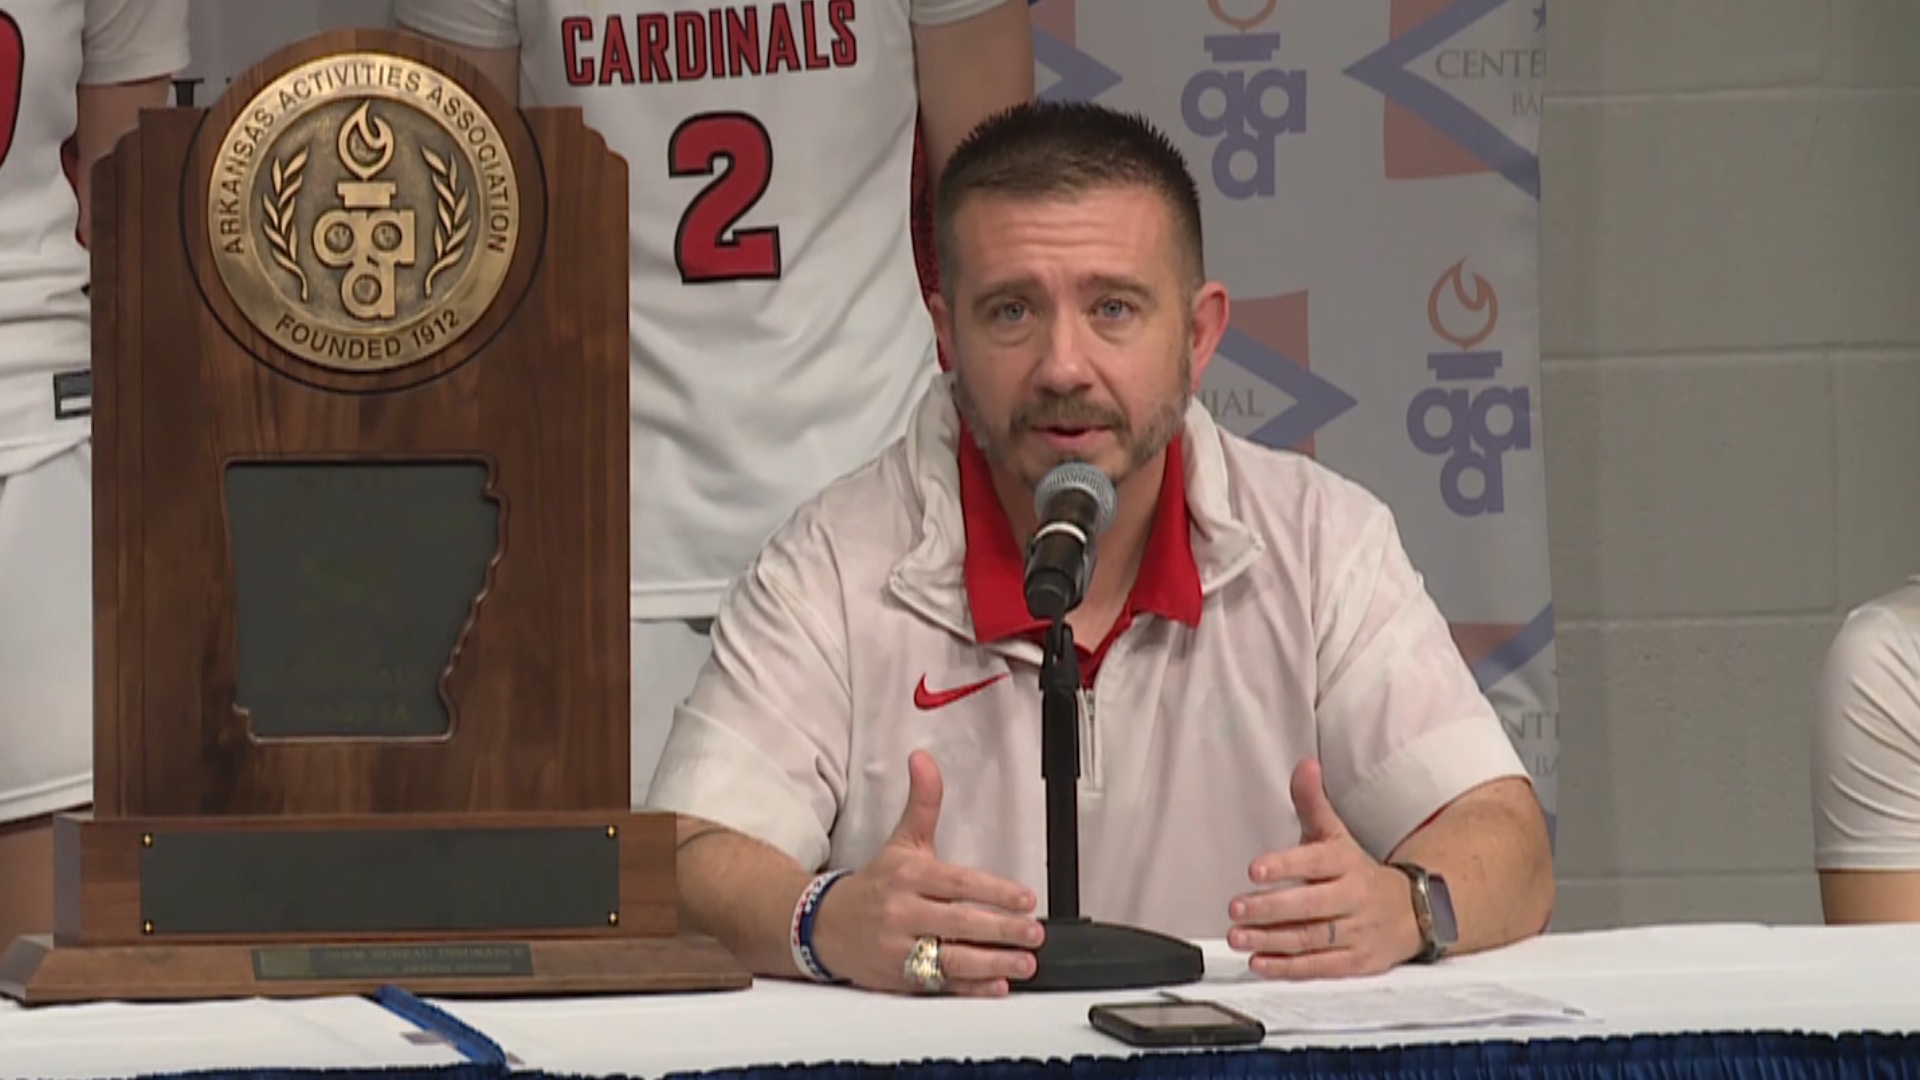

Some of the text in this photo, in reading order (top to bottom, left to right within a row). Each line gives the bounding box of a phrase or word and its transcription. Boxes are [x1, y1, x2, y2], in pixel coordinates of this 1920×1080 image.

[561, 0, 857, 87] CARDINALS
[1435, 48, 1547, 79] CENTE
[218, 62, 511, 255] ARKANSAS ACTIVITIES ASSOCIATION
[668, 110, 781, 284] 2
[275, 309, 460, 361] FOUNDED 1912
